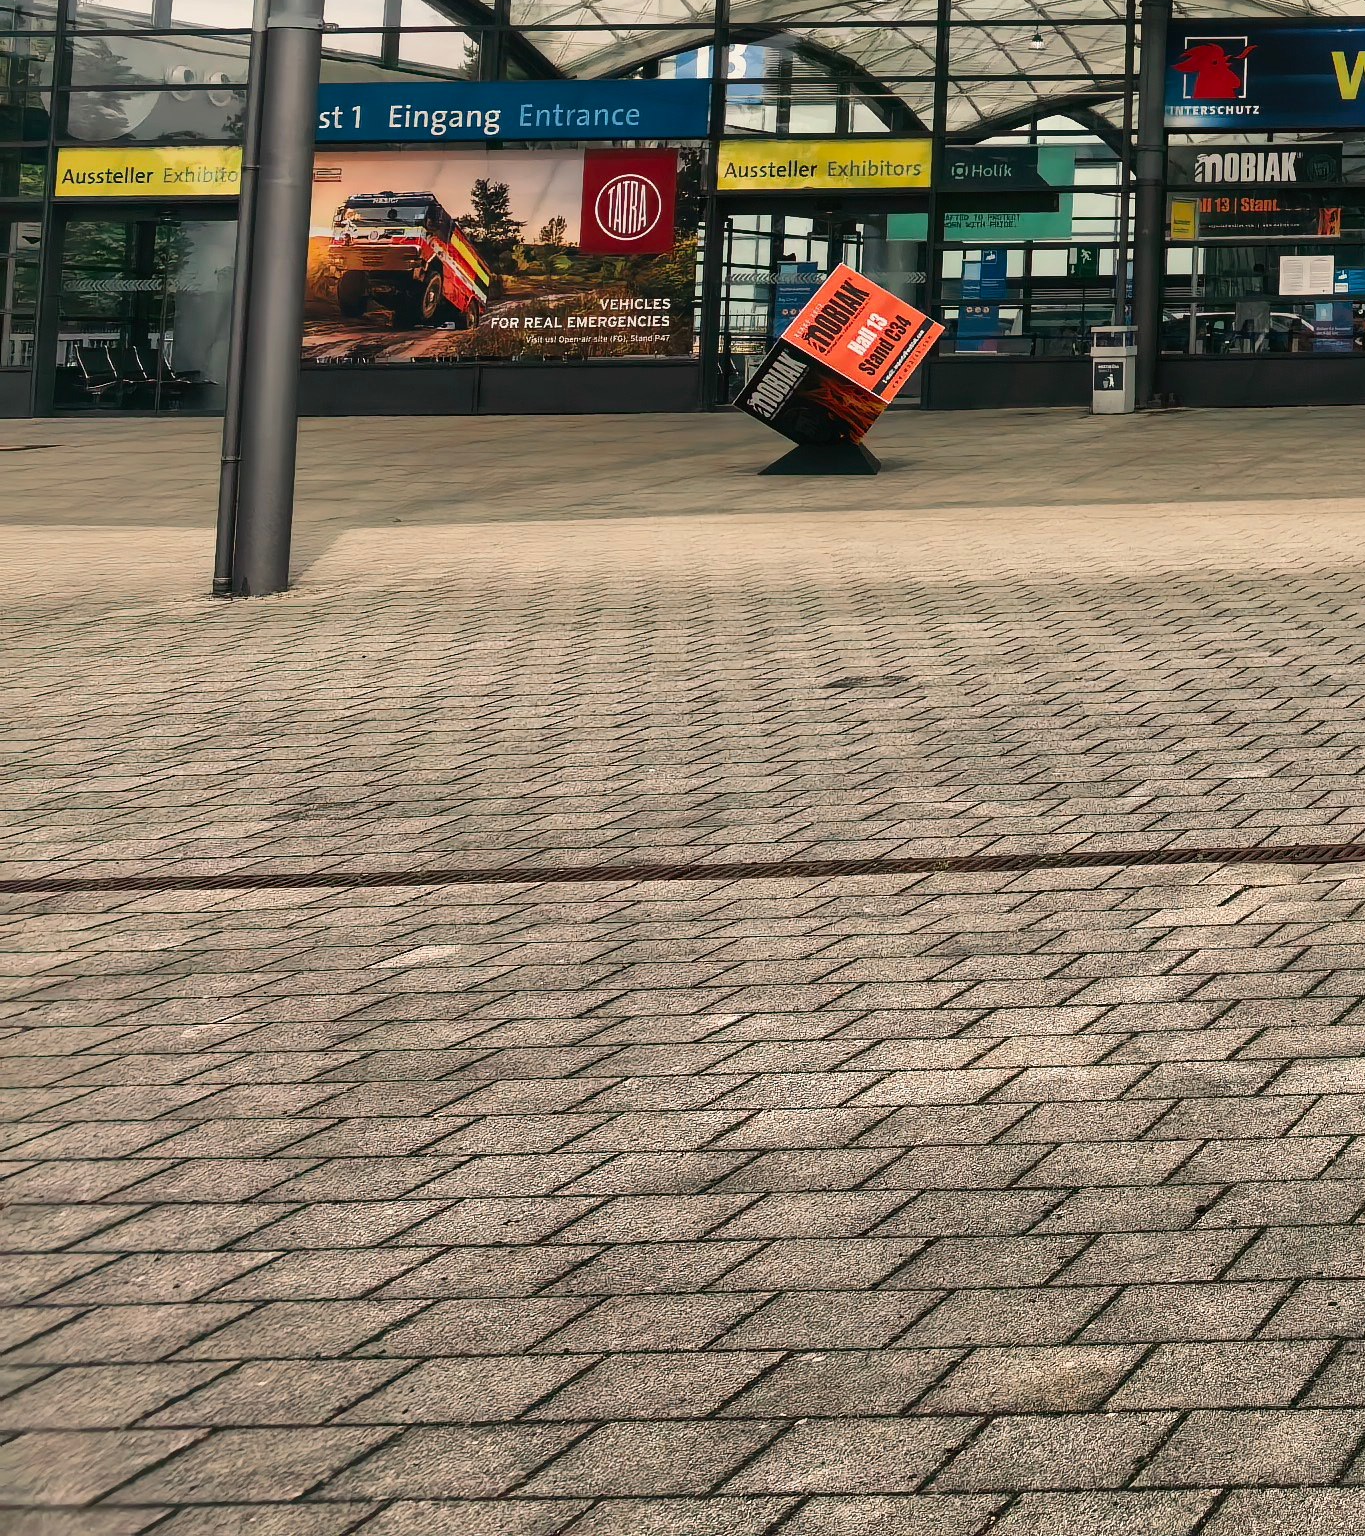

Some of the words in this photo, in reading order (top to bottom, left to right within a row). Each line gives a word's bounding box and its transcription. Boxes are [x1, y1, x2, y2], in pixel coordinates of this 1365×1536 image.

[318, 106, 343, 129] st
[352, 105, 362, 129] 1
[388, 104, 502, 136] Eingang
[519, 103, 640, 127] Entrance
[1169, 105, 1260, 116] INTERSCHUTZ
[61, 166, 154, 185] Aussteller
[163, 166, 239, 184] Exhibito
[724, 160, 818, 179] Aussteller
[827, 159, 922, 177] Exhibitors
[607, 180, 647, 234] TATRA
[1240, 197, 1281, 212] Stan
[600, 298, 671, 311] VEHICLES
[490, 317, 519, 329] FOR
[524, 316, 562, 329] REAL
[567, 315, 670, 328] EMERGENCIES
[630, 334, 653, 342] Stand
[846, 326, 878, 356] Hall
[866, 312, 889, 332] 13
[858, 337, 896, 376] Stand
[883, 314, 912, 342] C34
